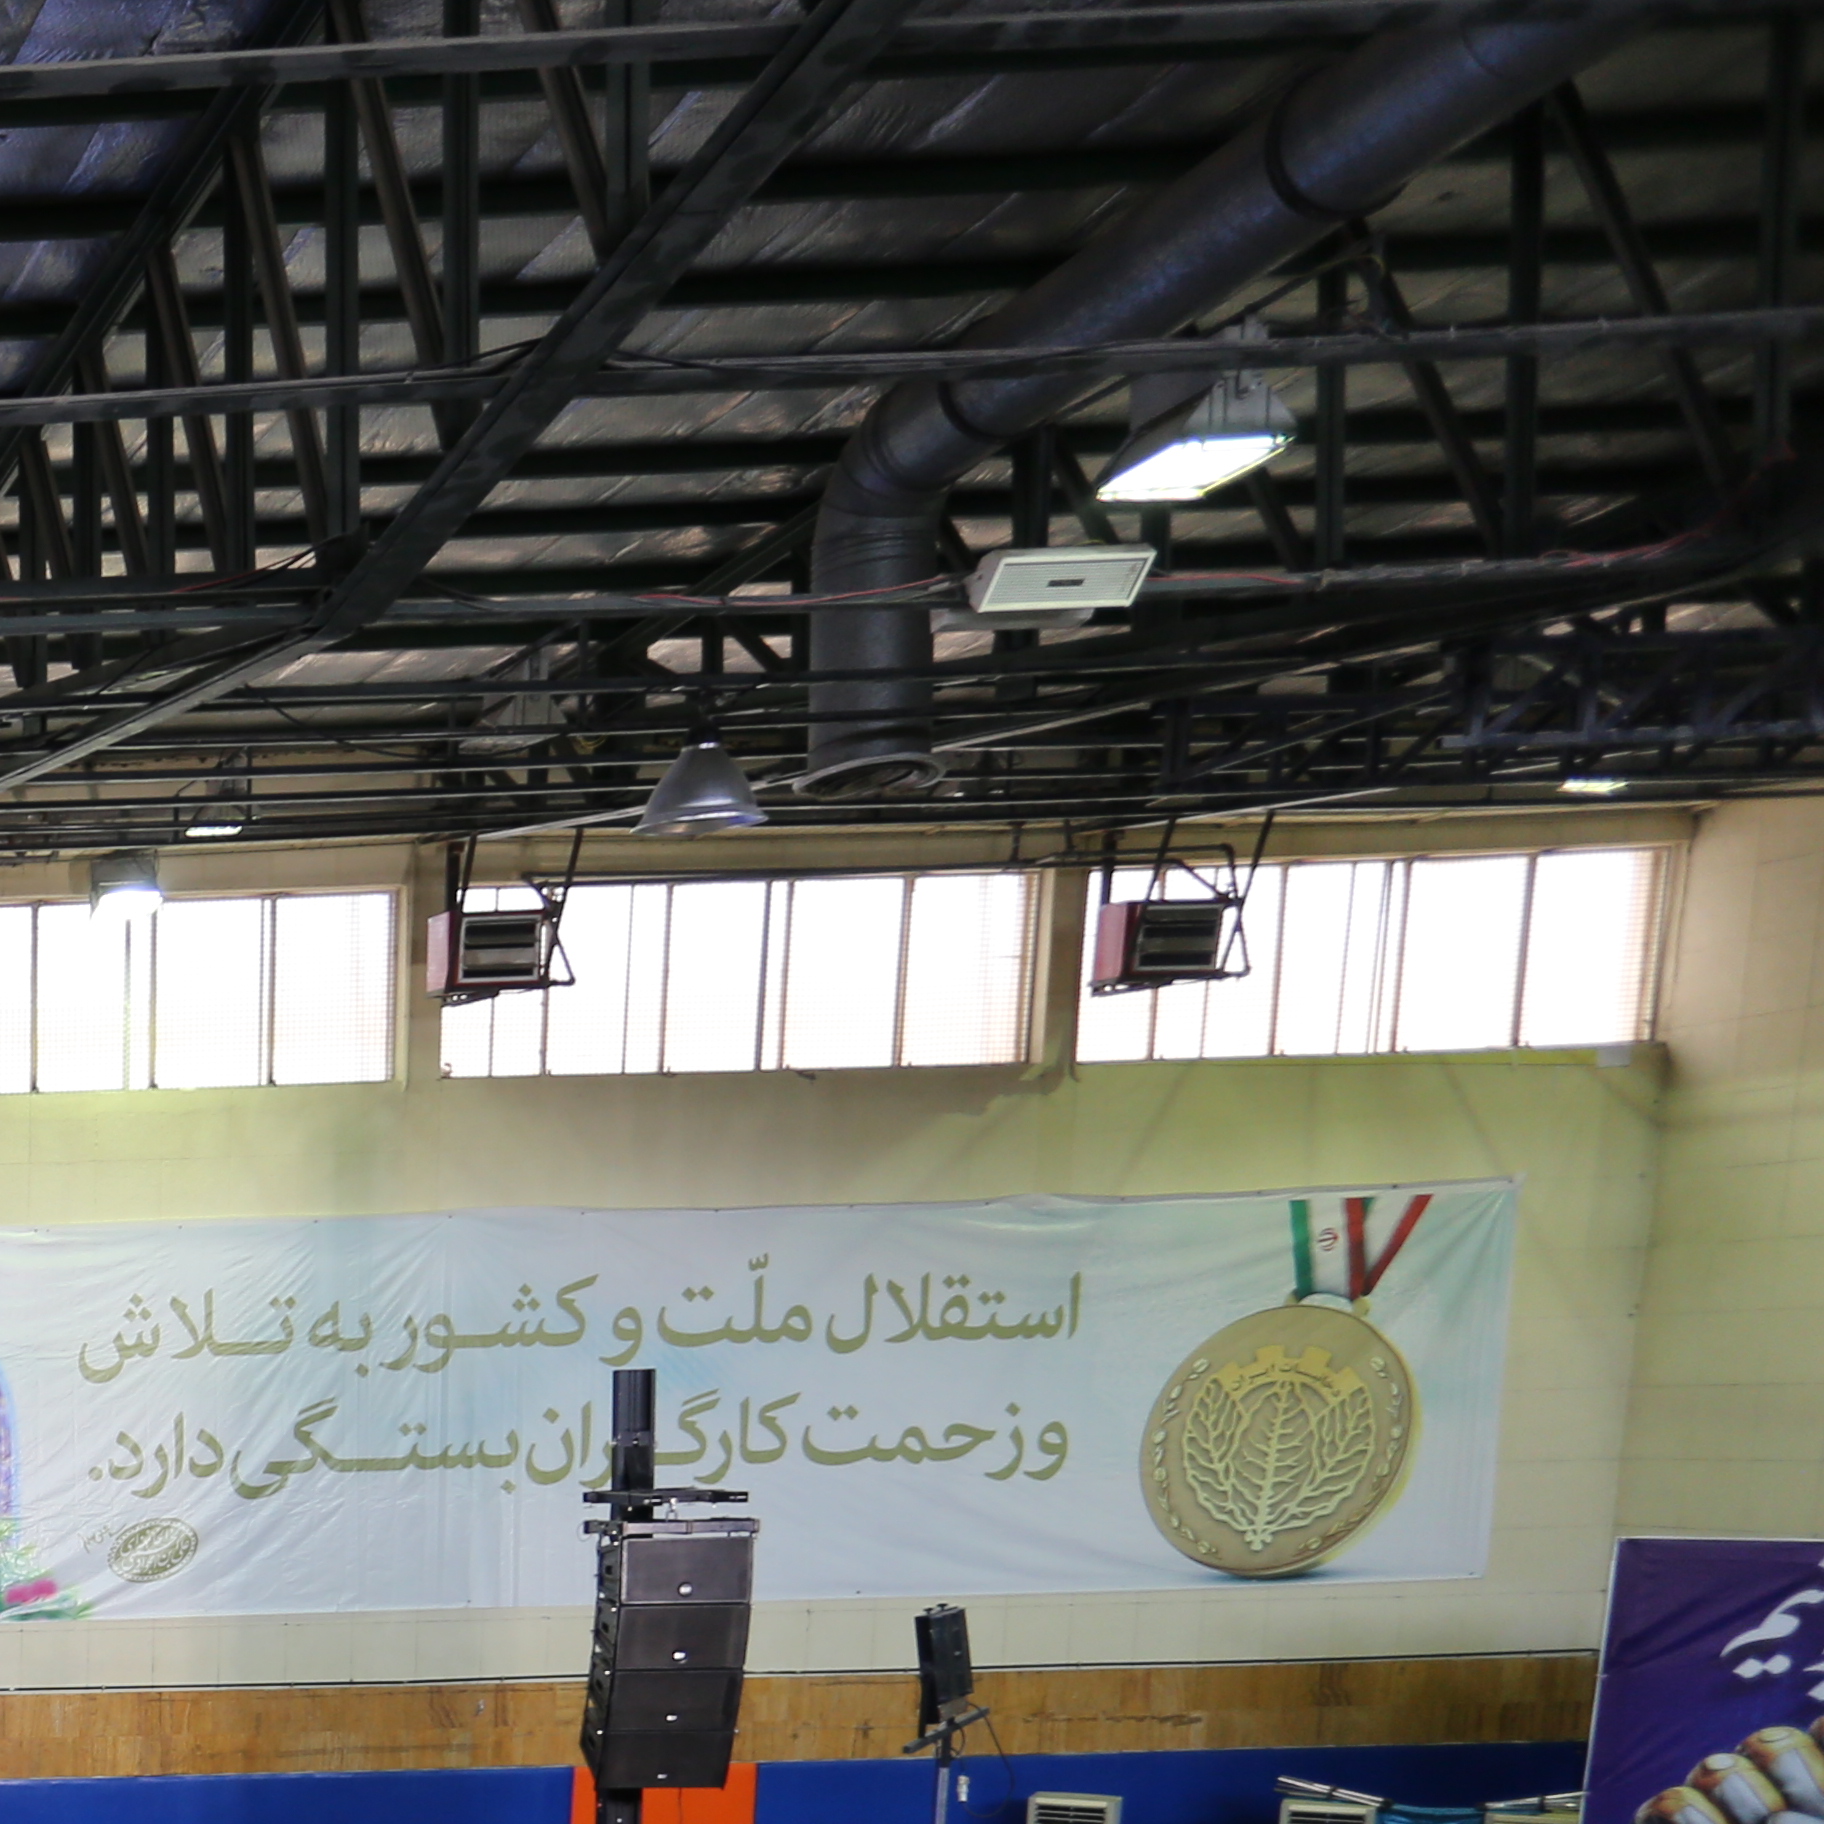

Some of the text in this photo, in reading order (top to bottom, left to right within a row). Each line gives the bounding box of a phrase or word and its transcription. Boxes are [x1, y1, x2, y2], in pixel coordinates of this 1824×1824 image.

[78, 1288, 297, 1383] تلاش
[308, 1300, 373, 1378] به
[379, 1274, 599, 1373] کشور
[599, 1306, 643, 1366] و
[825, 1271, 1081, 1354] استقلال
[231, 1397, 519, 1500] بستگی
[526, 1388, 801, 1490] کارگران
